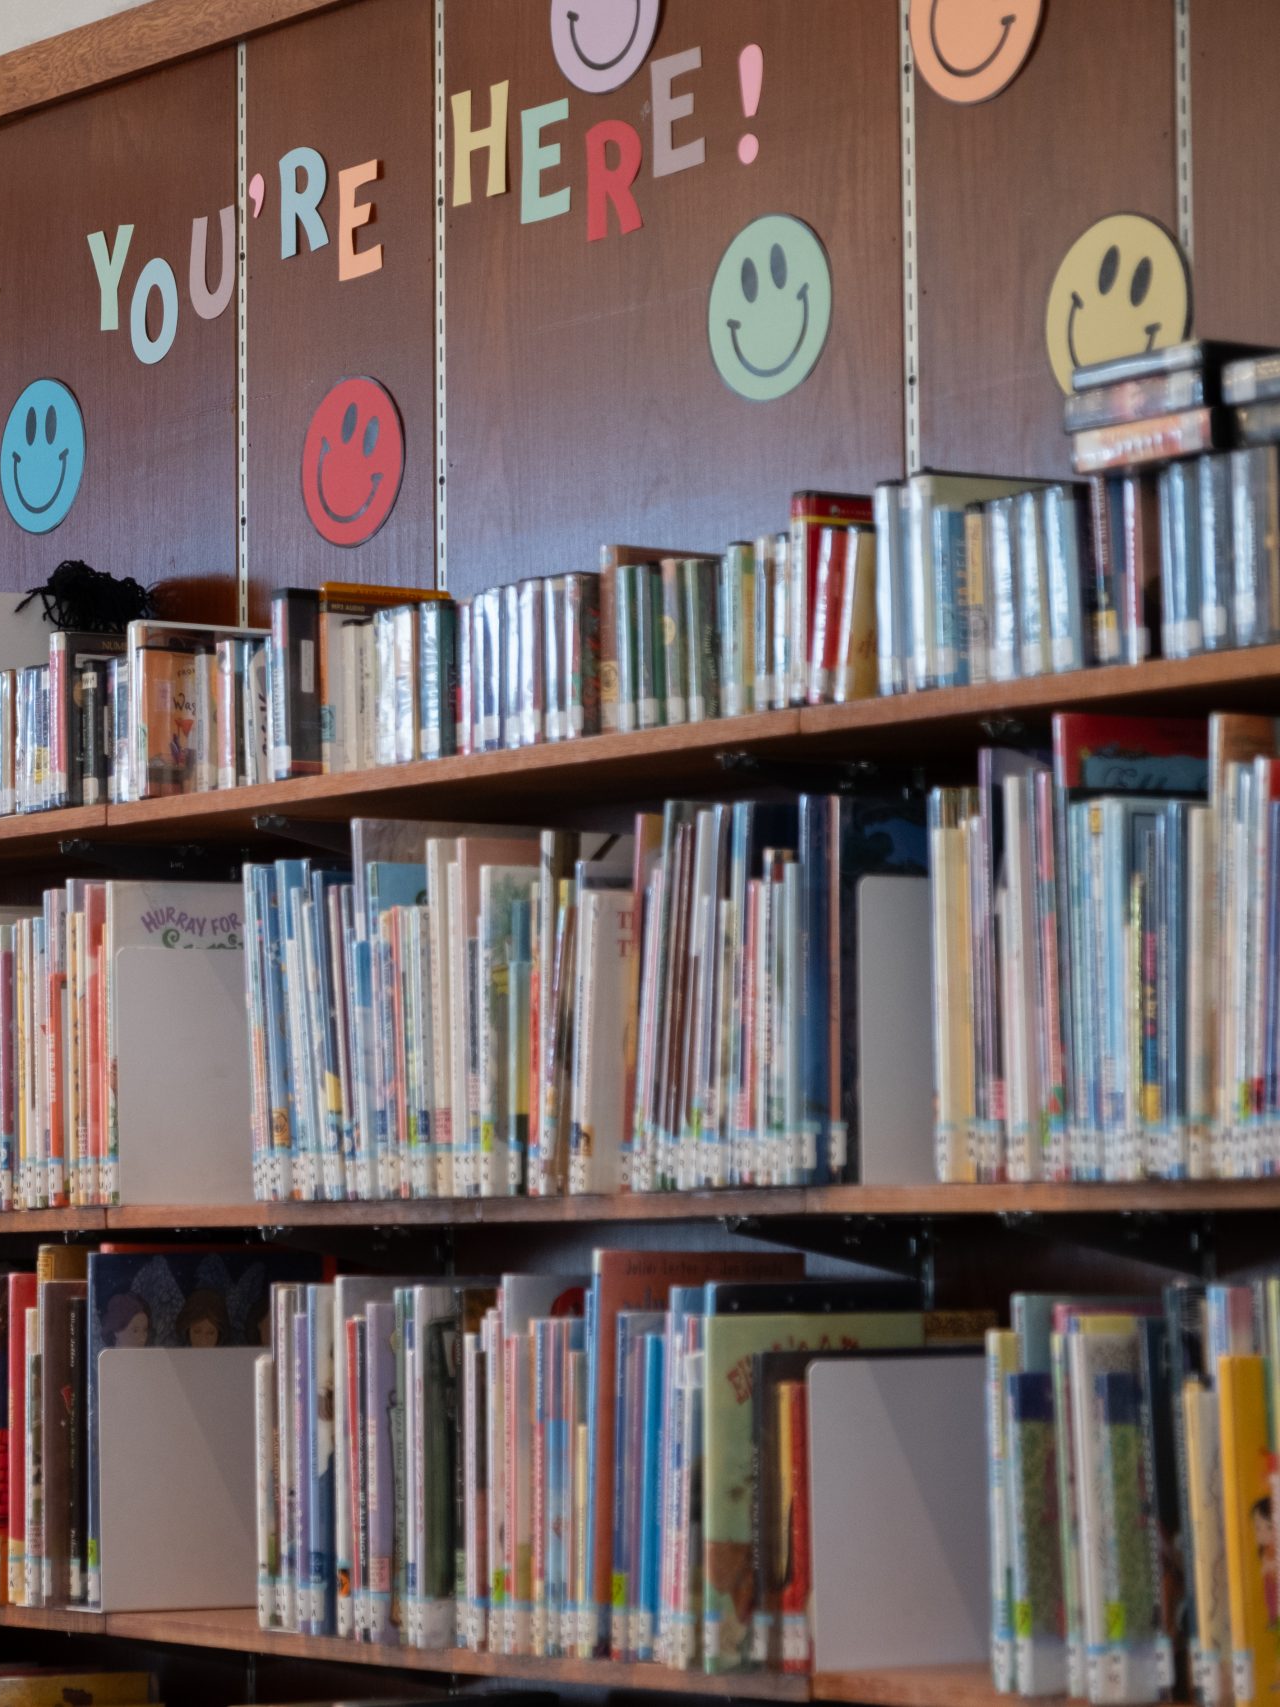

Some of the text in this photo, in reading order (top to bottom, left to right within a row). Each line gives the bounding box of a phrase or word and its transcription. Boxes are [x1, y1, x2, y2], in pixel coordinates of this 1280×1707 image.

[87, 147, 383, 364] YOU'RE
[140, 906, 243, 938] HURRAY FOR
